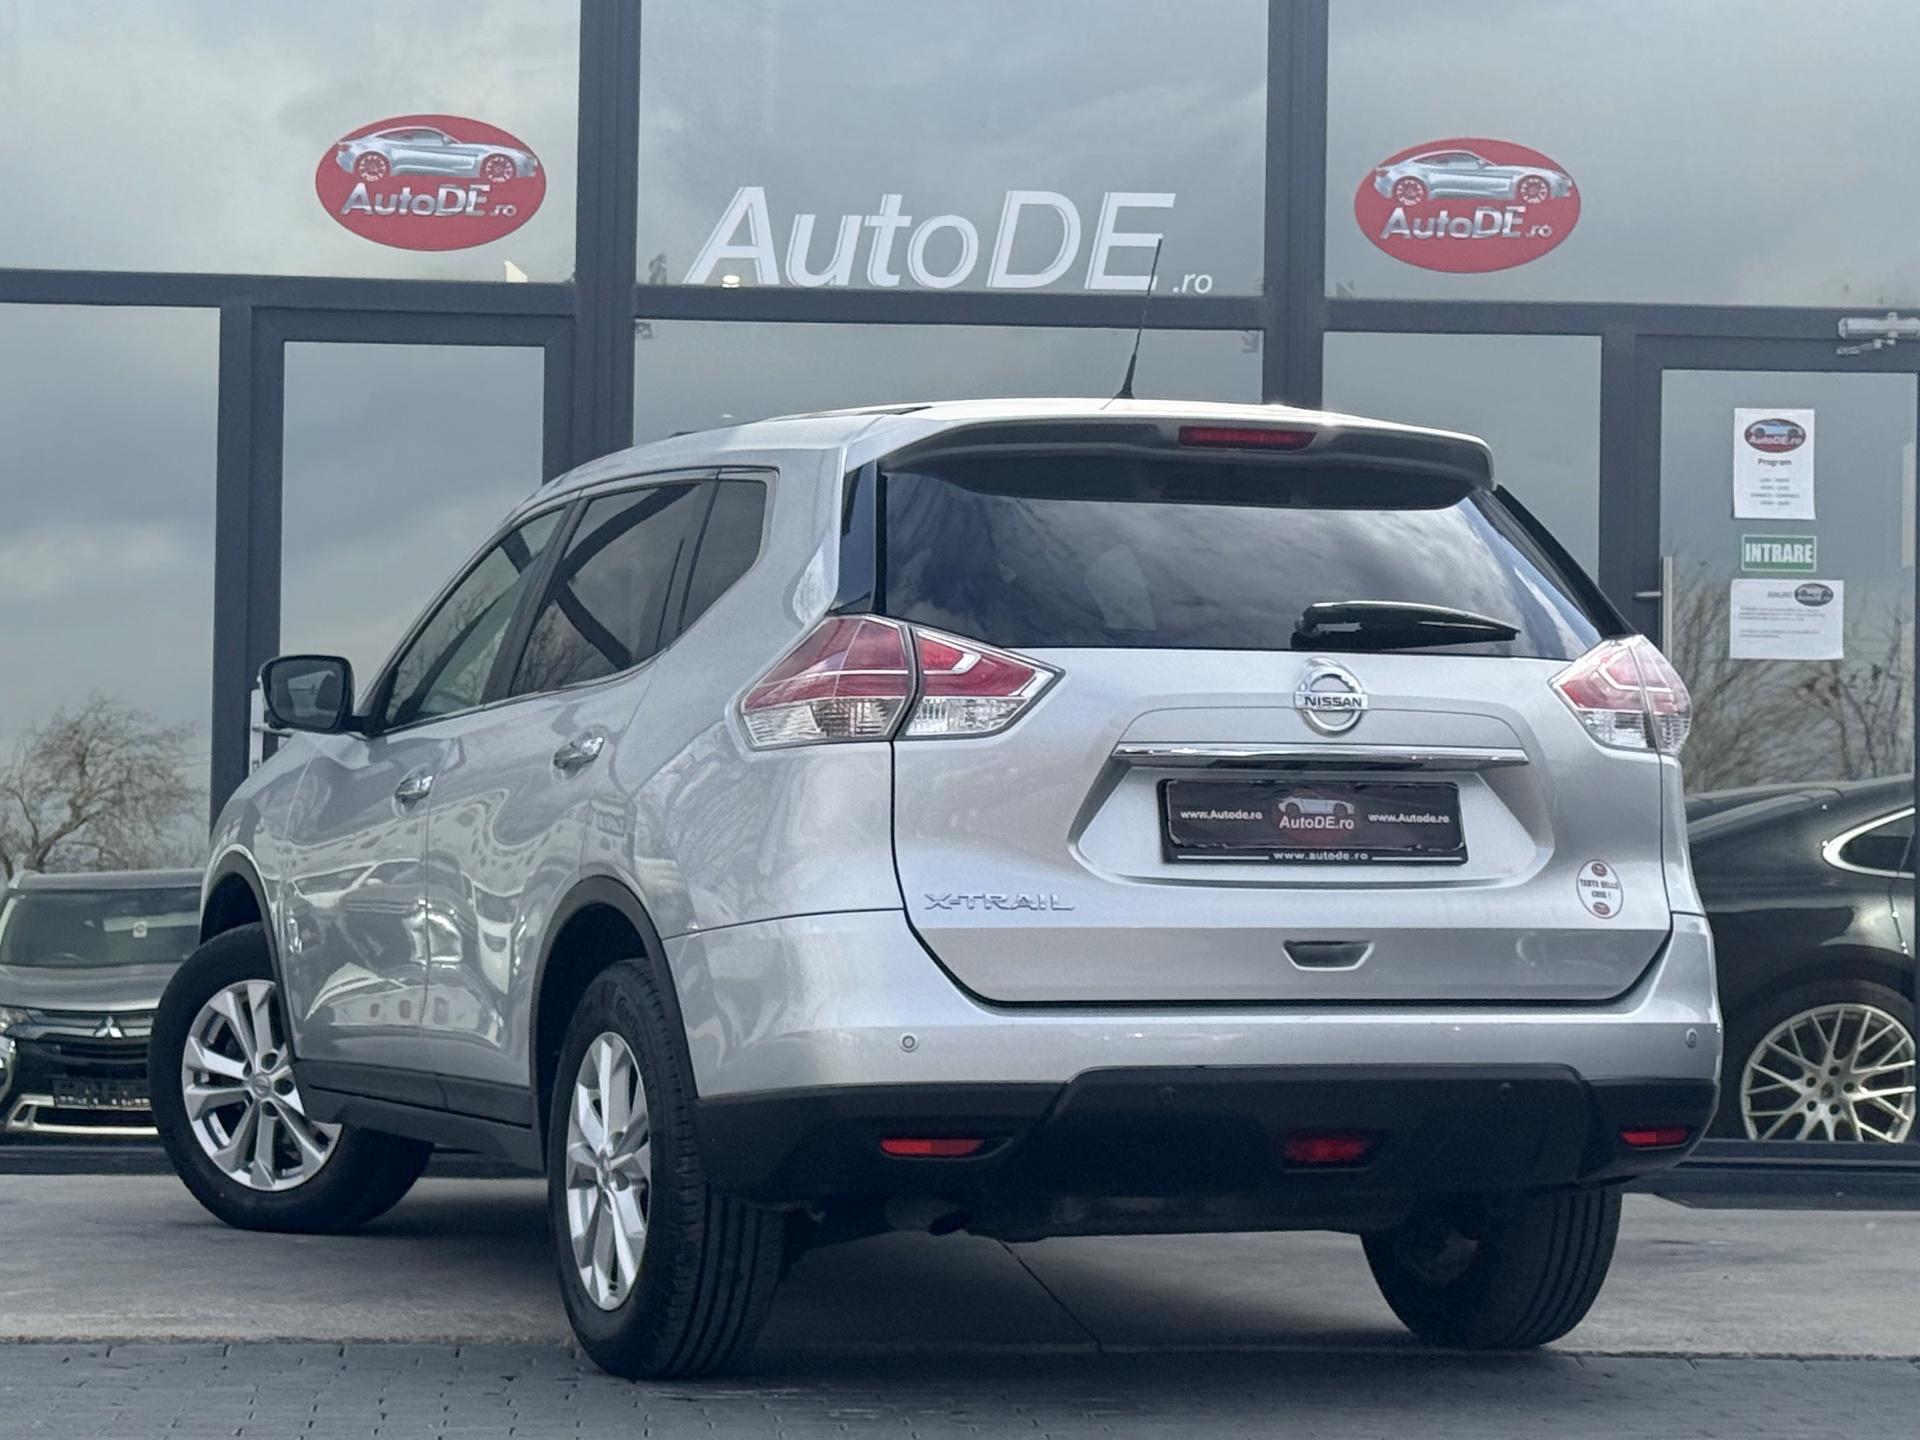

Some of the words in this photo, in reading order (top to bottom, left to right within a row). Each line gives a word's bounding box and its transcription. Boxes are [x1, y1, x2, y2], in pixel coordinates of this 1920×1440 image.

[1744, 543, 1813, 563] INTRARE
[1304, 696, 1362, 708] NISSAN
[1180, 809, 1263, 821] www.Autode.ro
[1367, 812, 1450, 825] www.Autode.ro
[1278, 815, 1354, 830] AutoDE.ro
[1273, 851, 1369, 861] www.autode.ro
[924, 893, 1075, 911] X-TRAIL
